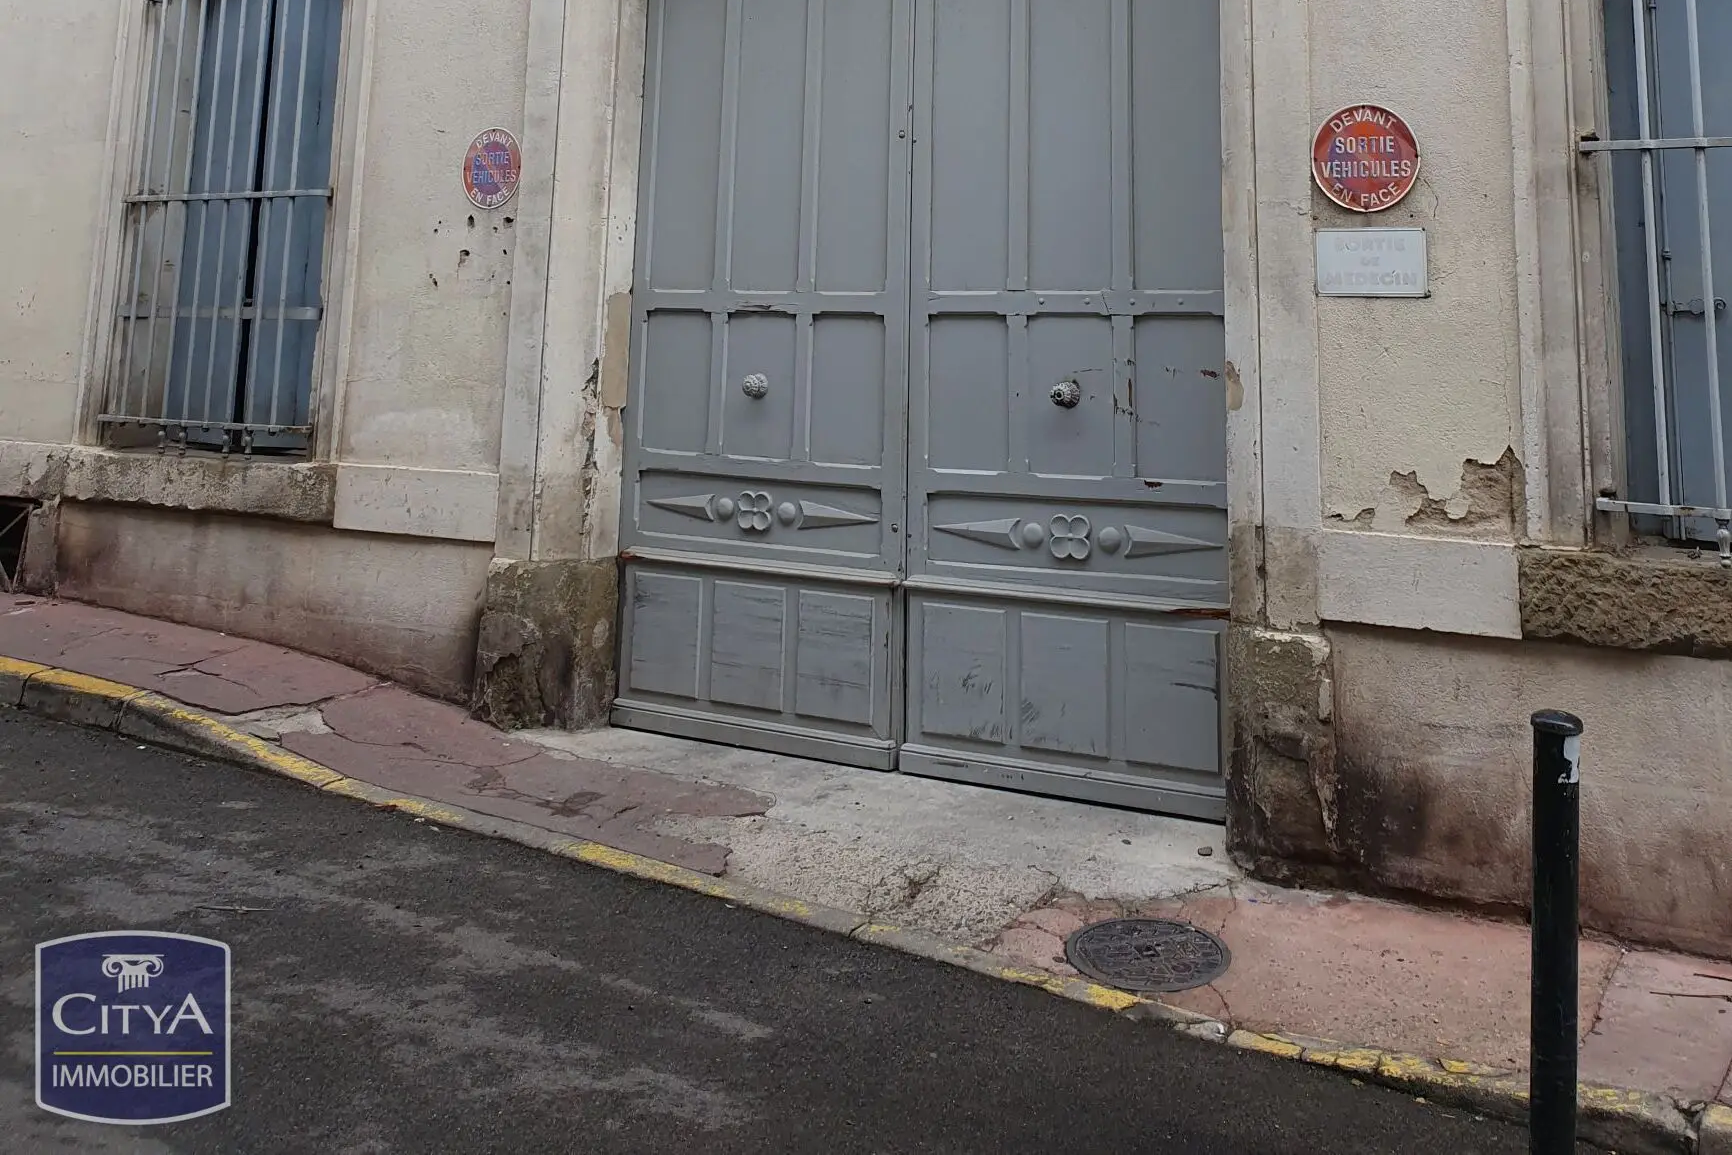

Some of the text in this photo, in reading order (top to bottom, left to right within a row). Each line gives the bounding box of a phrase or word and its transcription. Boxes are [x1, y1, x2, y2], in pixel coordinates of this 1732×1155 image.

[1329, 109, 1397, 133] DEVANT
[475, 131, 514, 149] DEVANT
[1335, 136, 1395, 154] SORTIE
[475, 151, 510, 166] SORTIE
[470, 186, 510, 205] EN FACE
[1331, 181, 1401, 207] EN FACE
